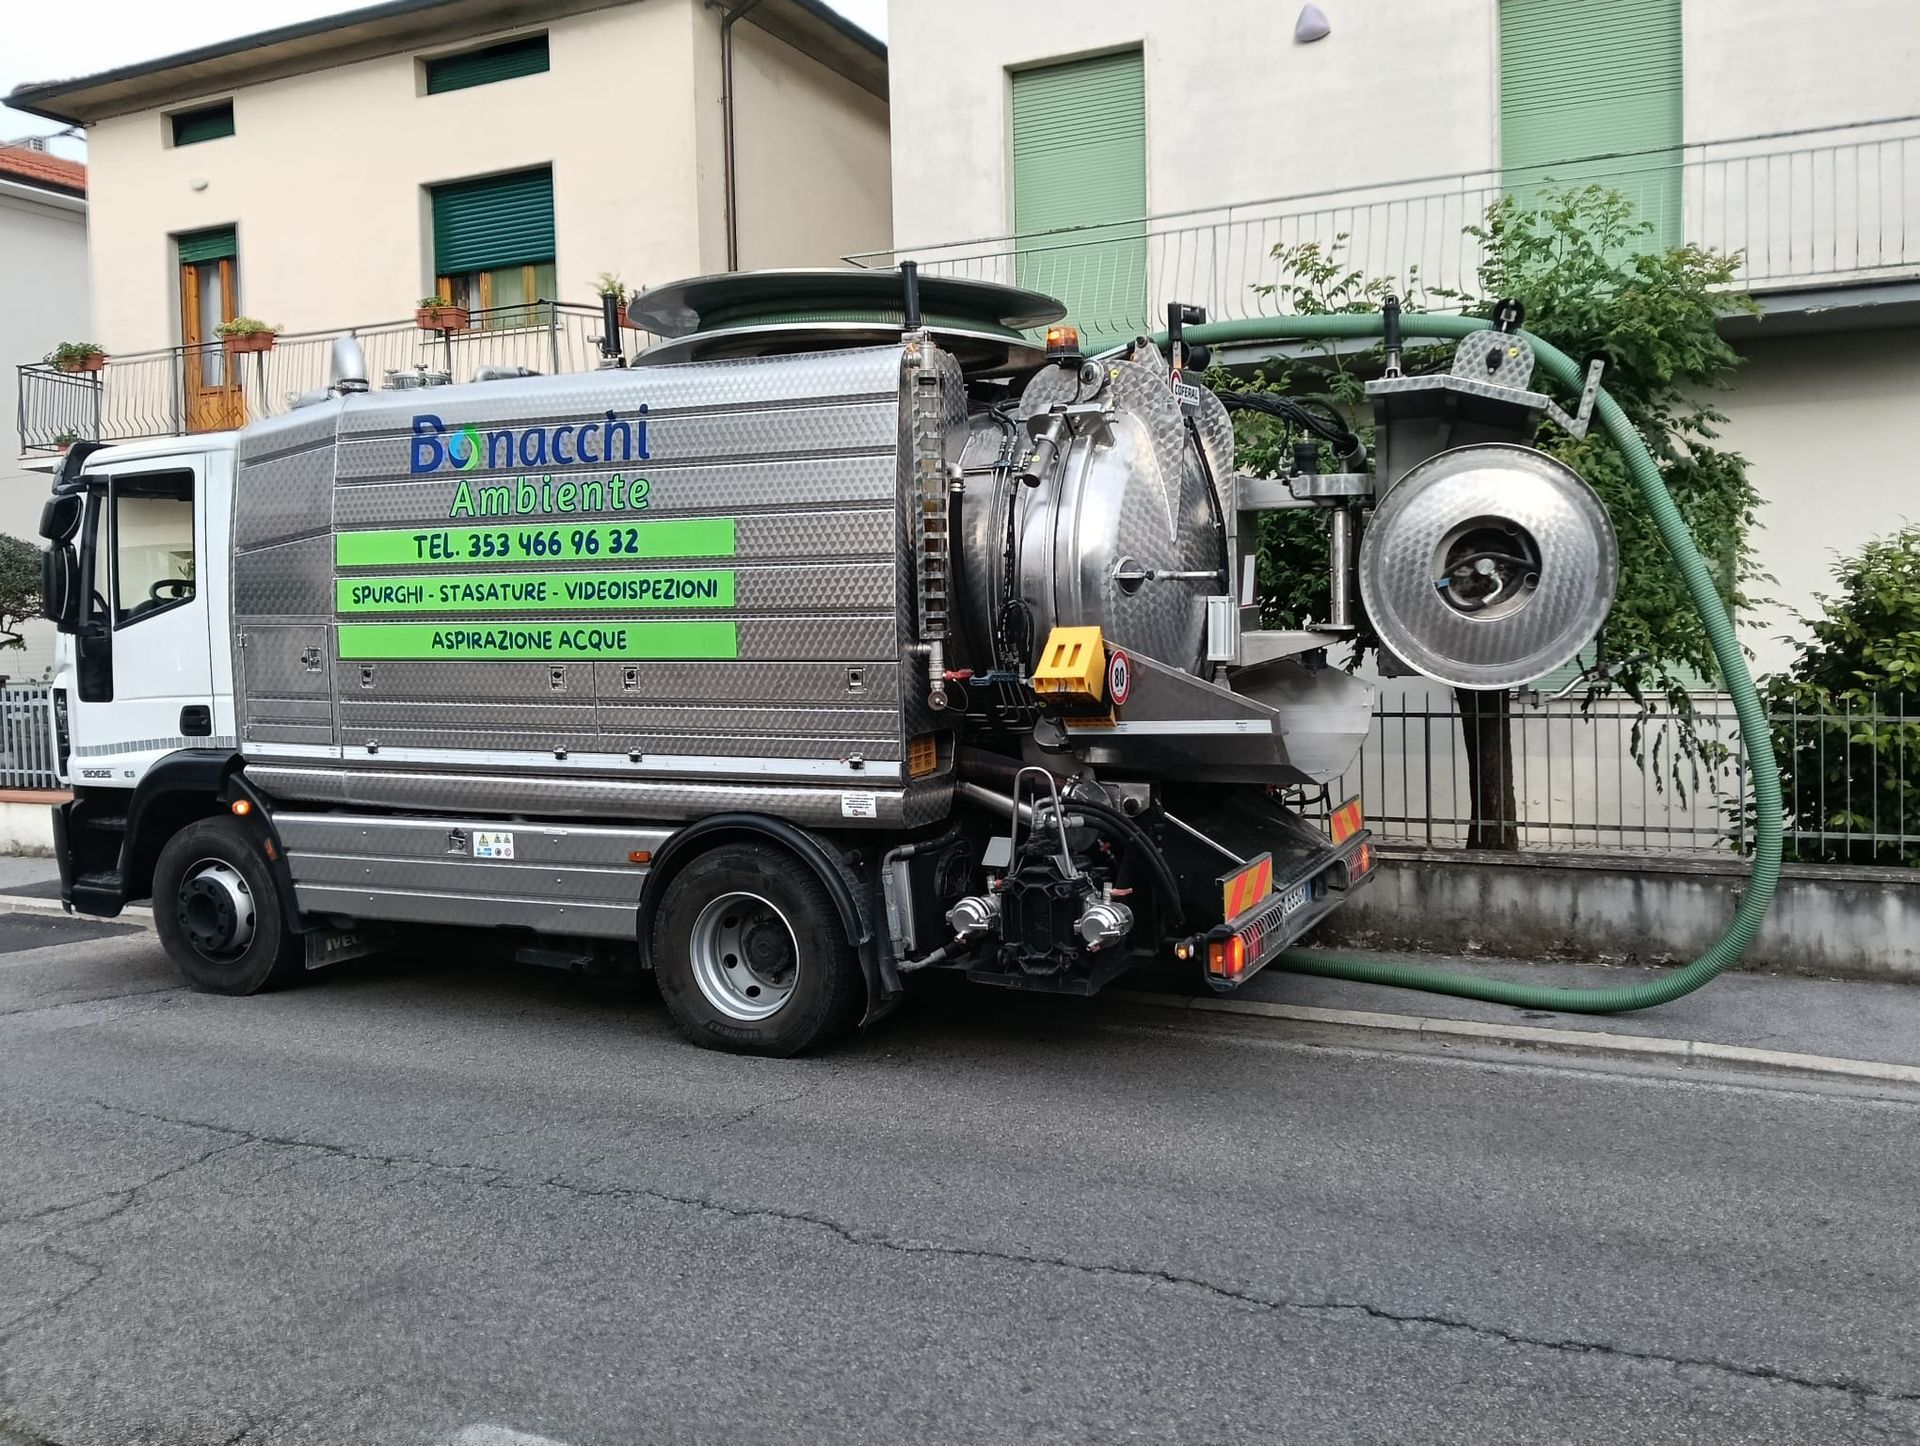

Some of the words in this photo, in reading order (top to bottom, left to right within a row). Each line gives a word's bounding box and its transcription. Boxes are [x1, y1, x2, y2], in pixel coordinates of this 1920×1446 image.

[410, 404, 650, 474] Bonacchi
[449, 473, 650, 518] Ambiente
[413, 532, 460, 560] TEL.
[468, 533, 510, 558] 353
[518, 530, 562, 557] 466
[570, 529, 600, 555] 96
[608, 528, 639, 554] 32
[352, 585, 423, 605] SPURGHI
[439, 581, 547, 603] STASATURE
[564, 578, 718, 601] VIDEOISPEZIONI
[431, 629, 553, 651] ASPIRAZIONE
[558, 629, 627, 652] ACQUE
[1114, 666, 1125, 688] 80
